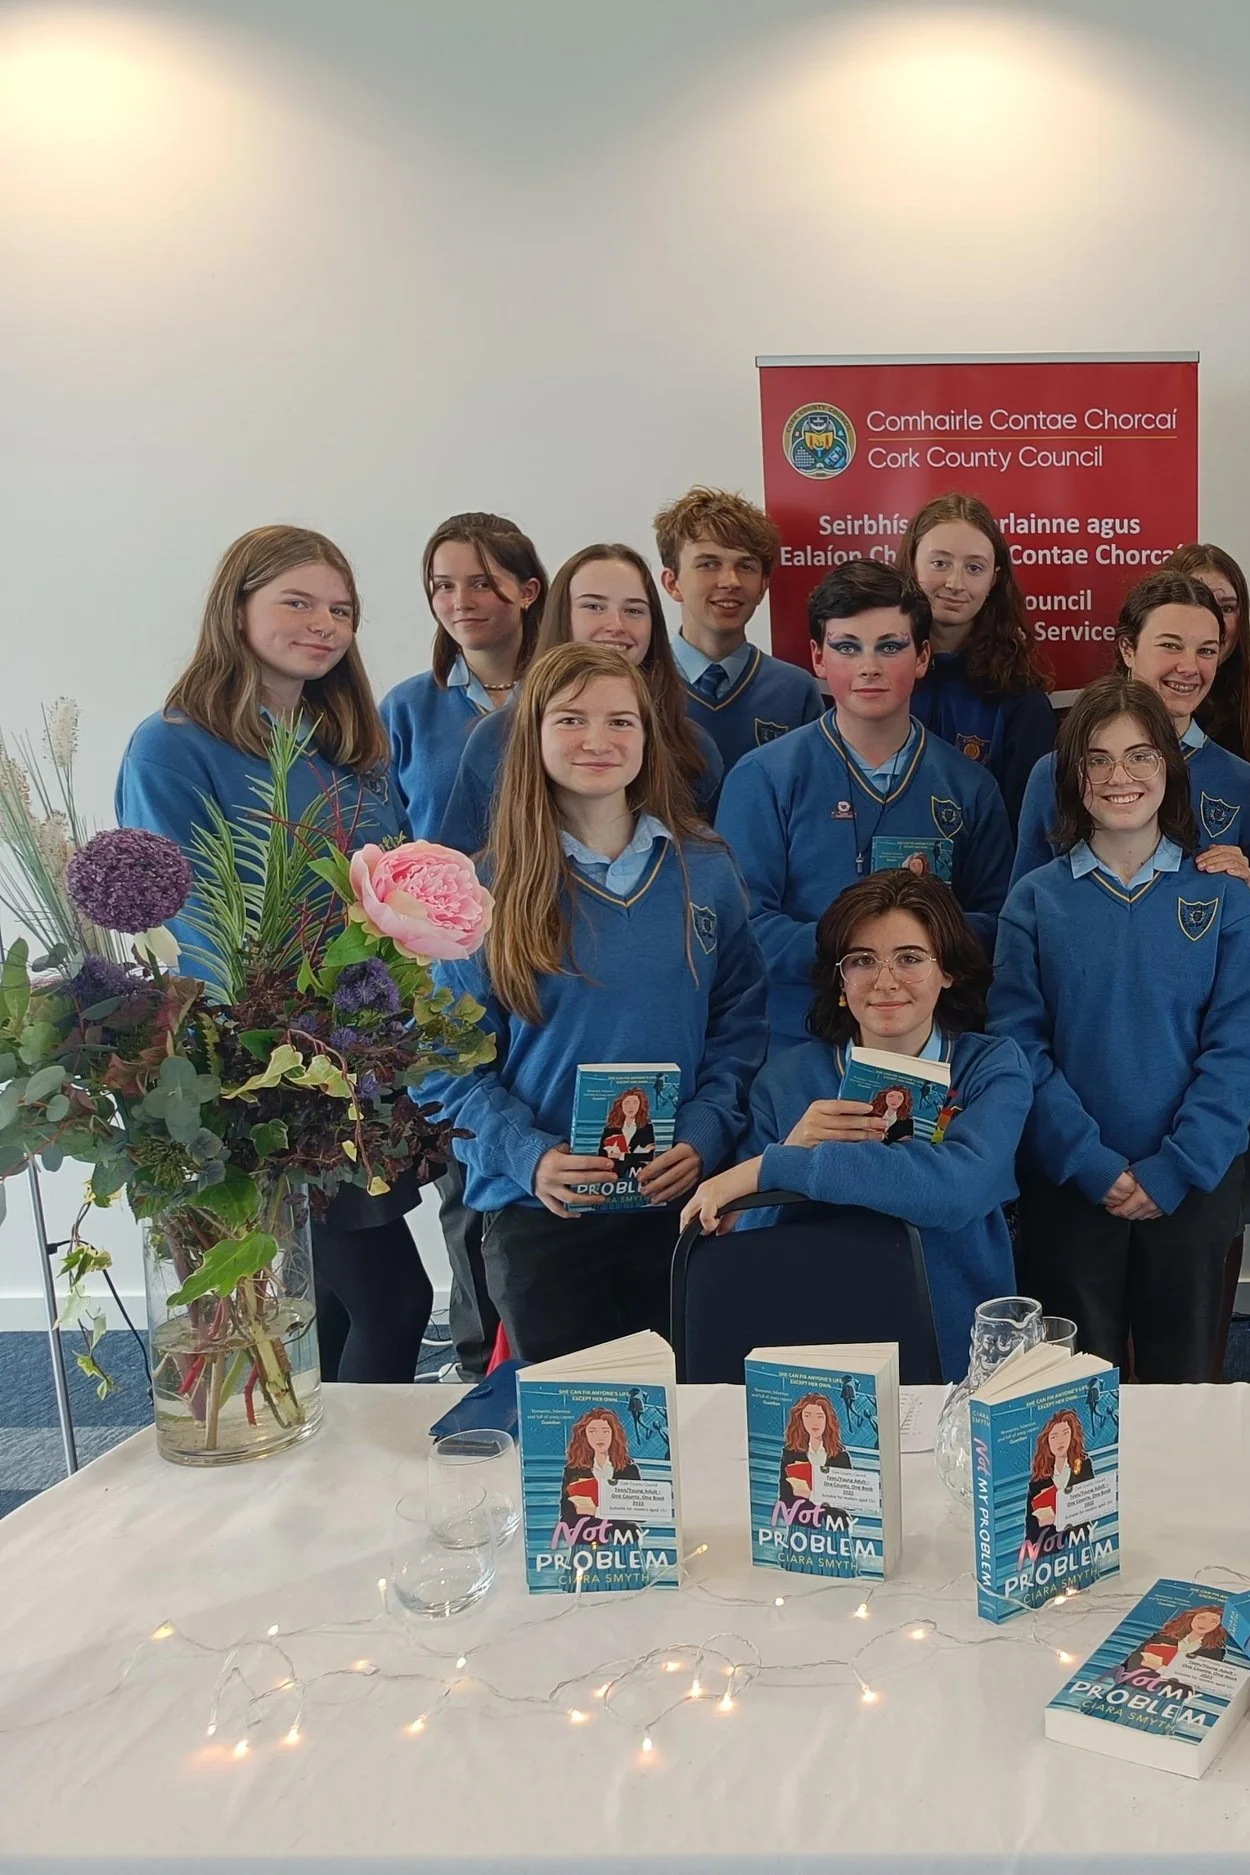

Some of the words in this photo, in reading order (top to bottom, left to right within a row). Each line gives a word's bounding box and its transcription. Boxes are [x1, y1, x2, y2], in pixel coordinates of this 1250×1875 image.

[867, 410, 983, 432] Comhairle
[990, 409, 1077, 430] Contae
[1084, 408, 1177, 430] Chorcaí
[868, 447, 920, 469] Cork
[927, 447, 1011, 472] County
[1018, 445, 1103, 467] Council
[819, 514, 909, 535] Seirbhís
[996, 513, 1080, 534] rlainne
[1087, 517, 1141, 539] agus
[1009, 545, 1088, 565] Contae
[1095, 544, 1184, 565] Chorca
[1026, 590, 1092, 611] ouncil
[1034, 621, 1116, 641] Service
[577, 1181, 643, 1195] PROBL
[977, 1477, 989, 1506] MY
[771, 1500, 825, 1529] Not
[826, 1515, 860, 1532] MY
[551, 1515, 614, 1550] Not
[613, 1528, 651, 1545] MY
[758, 1528, 876, 1558] PROBLEM
[1068, 1520, 1099, 1549] MY
[978, 1506, 992, 1588] PROBLEM
[536, 1549, 670, 1573] PROBLEM
[778, 1553, 814, 1565] CIARA
[818, 1557, 858, 1570] SMYTH
[1004, 1539, 1113, 1598] PROBLEM
[605, 1573, 650, 1583] SMYTH
[1024, 1584, 1057, 1604] CIARA
[1062, 1568, 1099, 1587] SMYTH
[1068, 1681, 1206, 1727] PROBLEM
[1158, 1684, 1203, 1702] MY
[1081, 1700, 1124, 1717] CIARA
[1129, 1712, 1176, 1731] SMYTH
